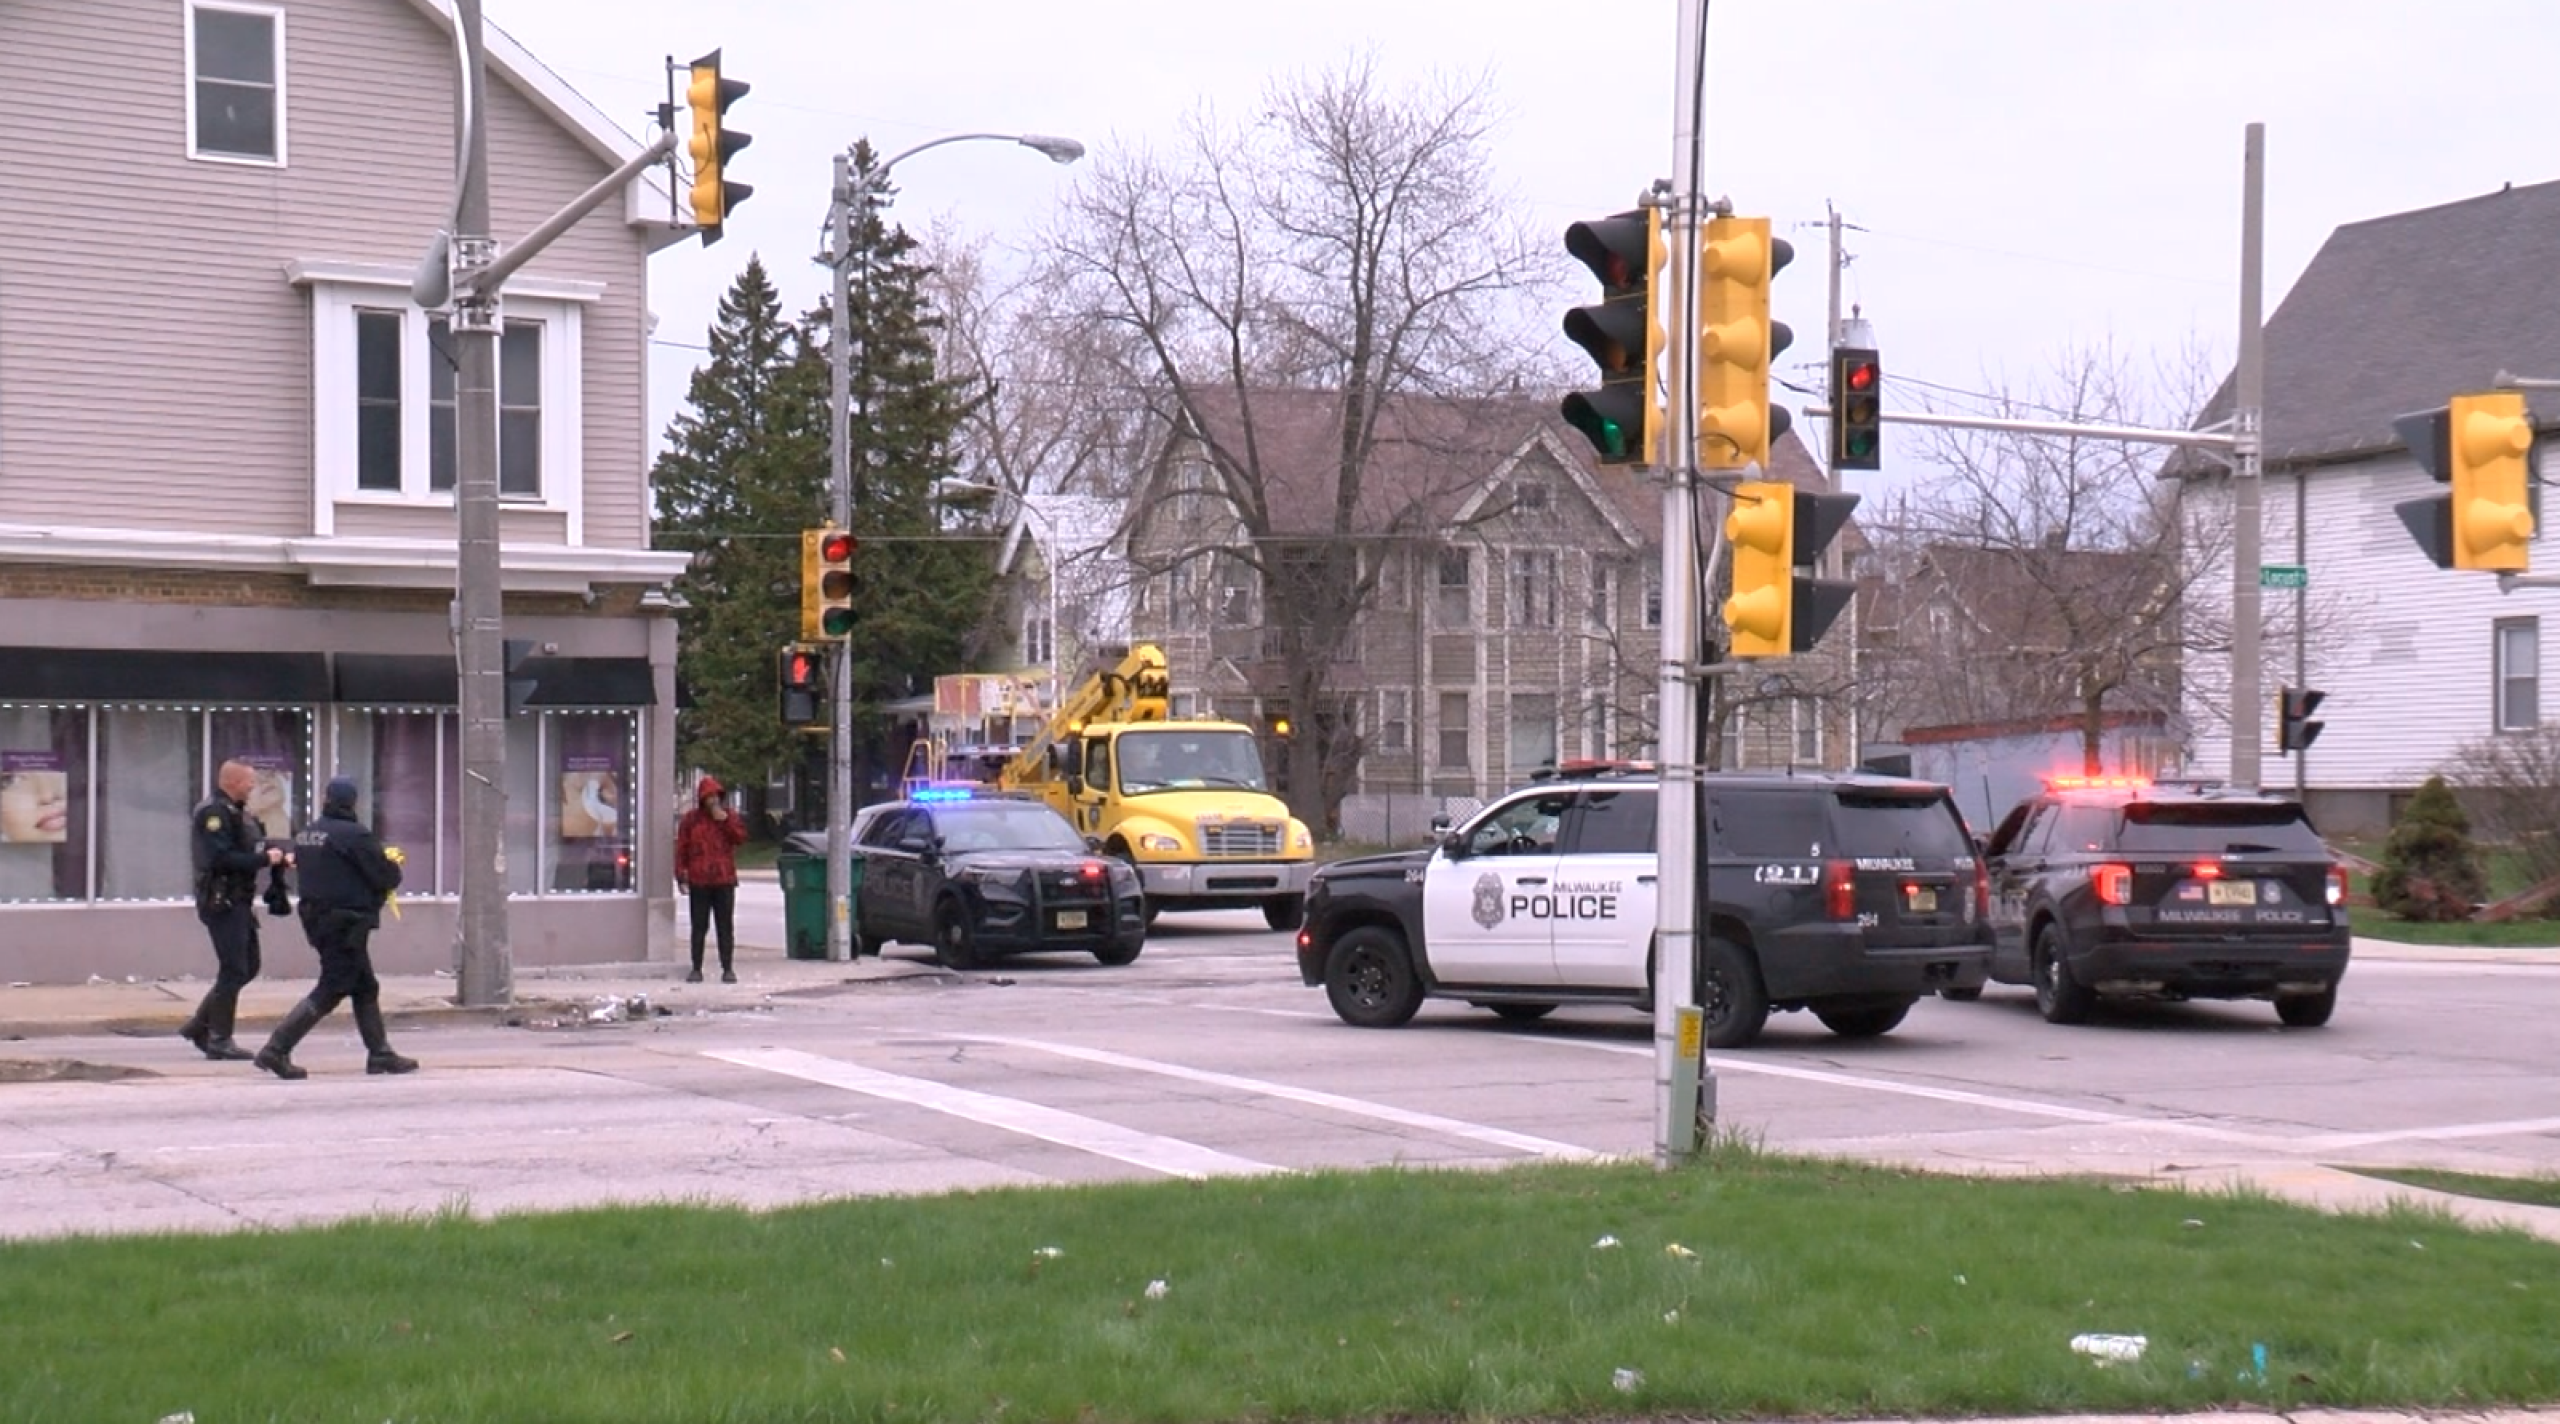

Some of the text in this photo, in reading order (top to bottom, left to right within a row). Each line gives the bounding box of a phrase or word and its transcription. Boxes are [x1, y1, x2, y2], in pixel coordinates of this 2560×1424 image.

[1404, 868, 1424, 883] 264
[1553, 881, 1622, 894] MILWAUKEE
[1511, 896, 1617, 919] POLICE
[2159, 909, 2302, 922] MILWAUKEE POLICE
